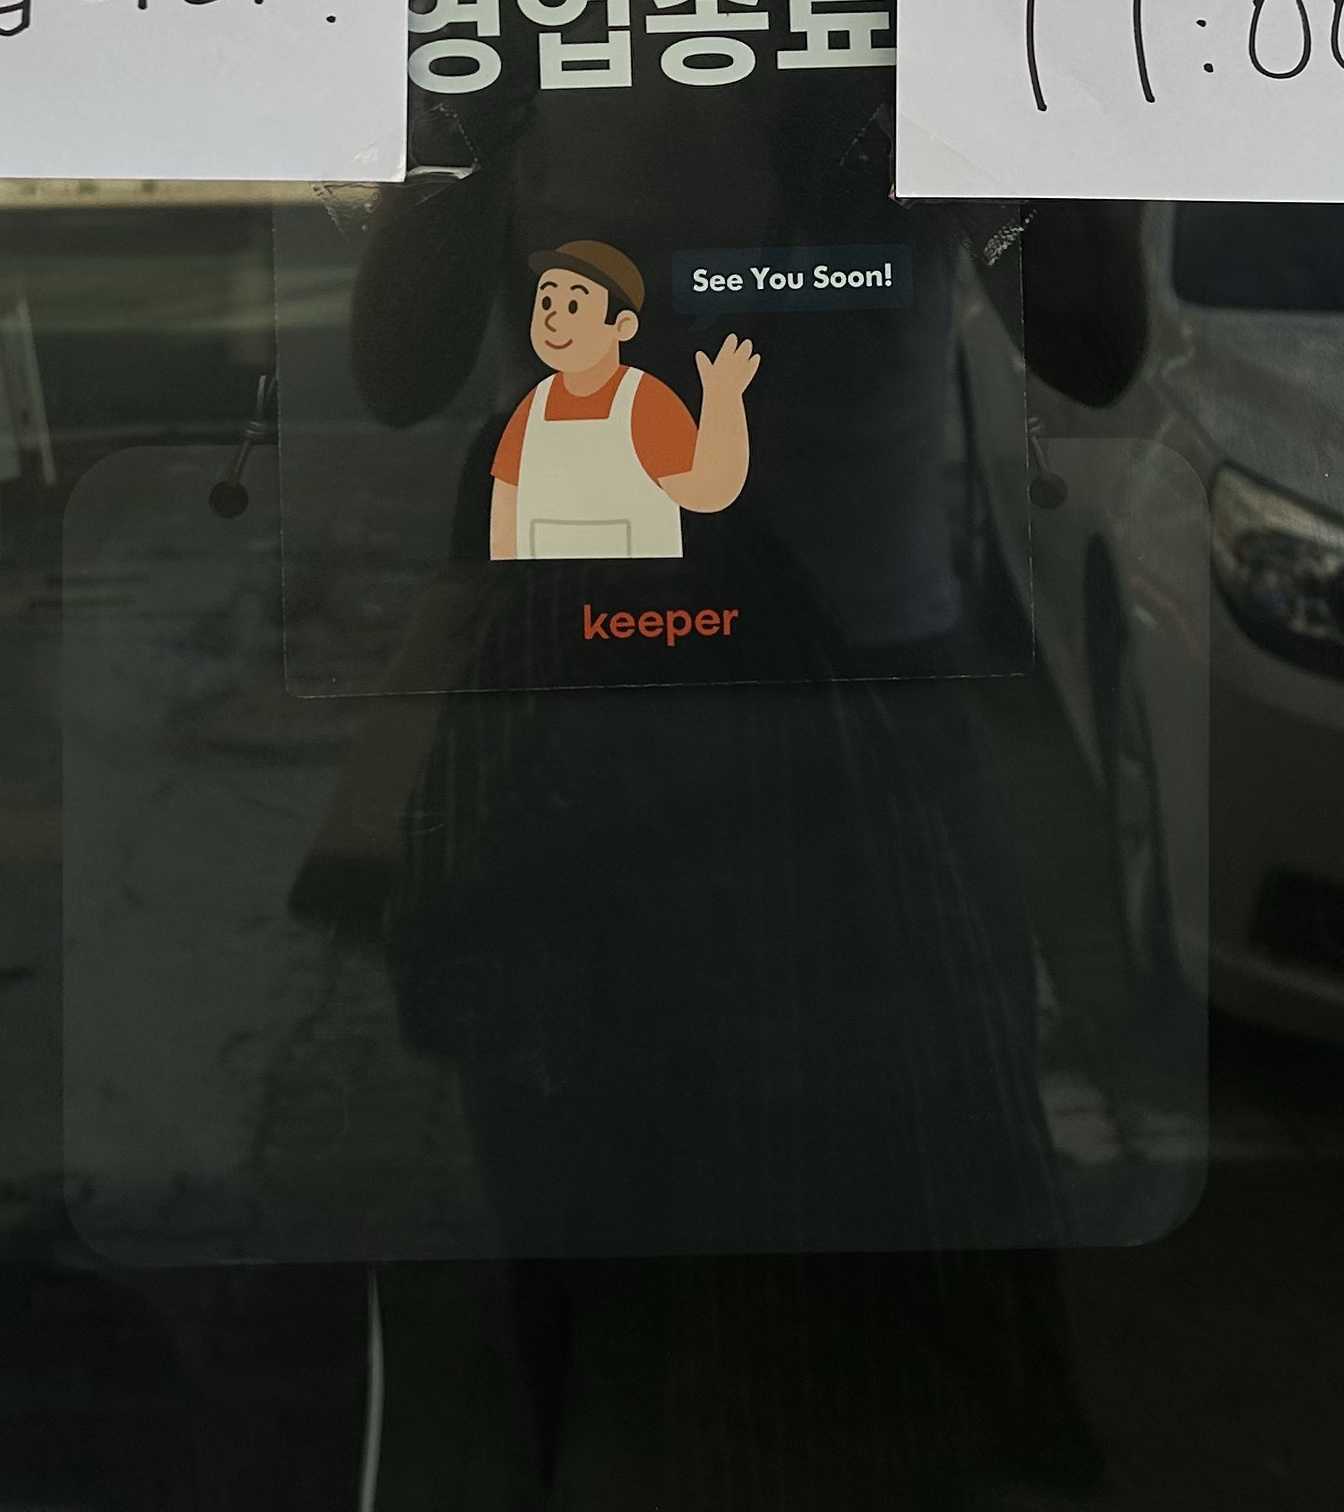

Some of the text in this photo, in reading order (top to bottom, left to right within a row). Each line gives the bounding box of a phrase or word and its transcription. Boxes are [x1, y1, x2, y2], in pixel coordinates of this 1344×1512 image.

[693, 262, 892, 292] See You Soon!
[582, 603, 739, 646] keeper
